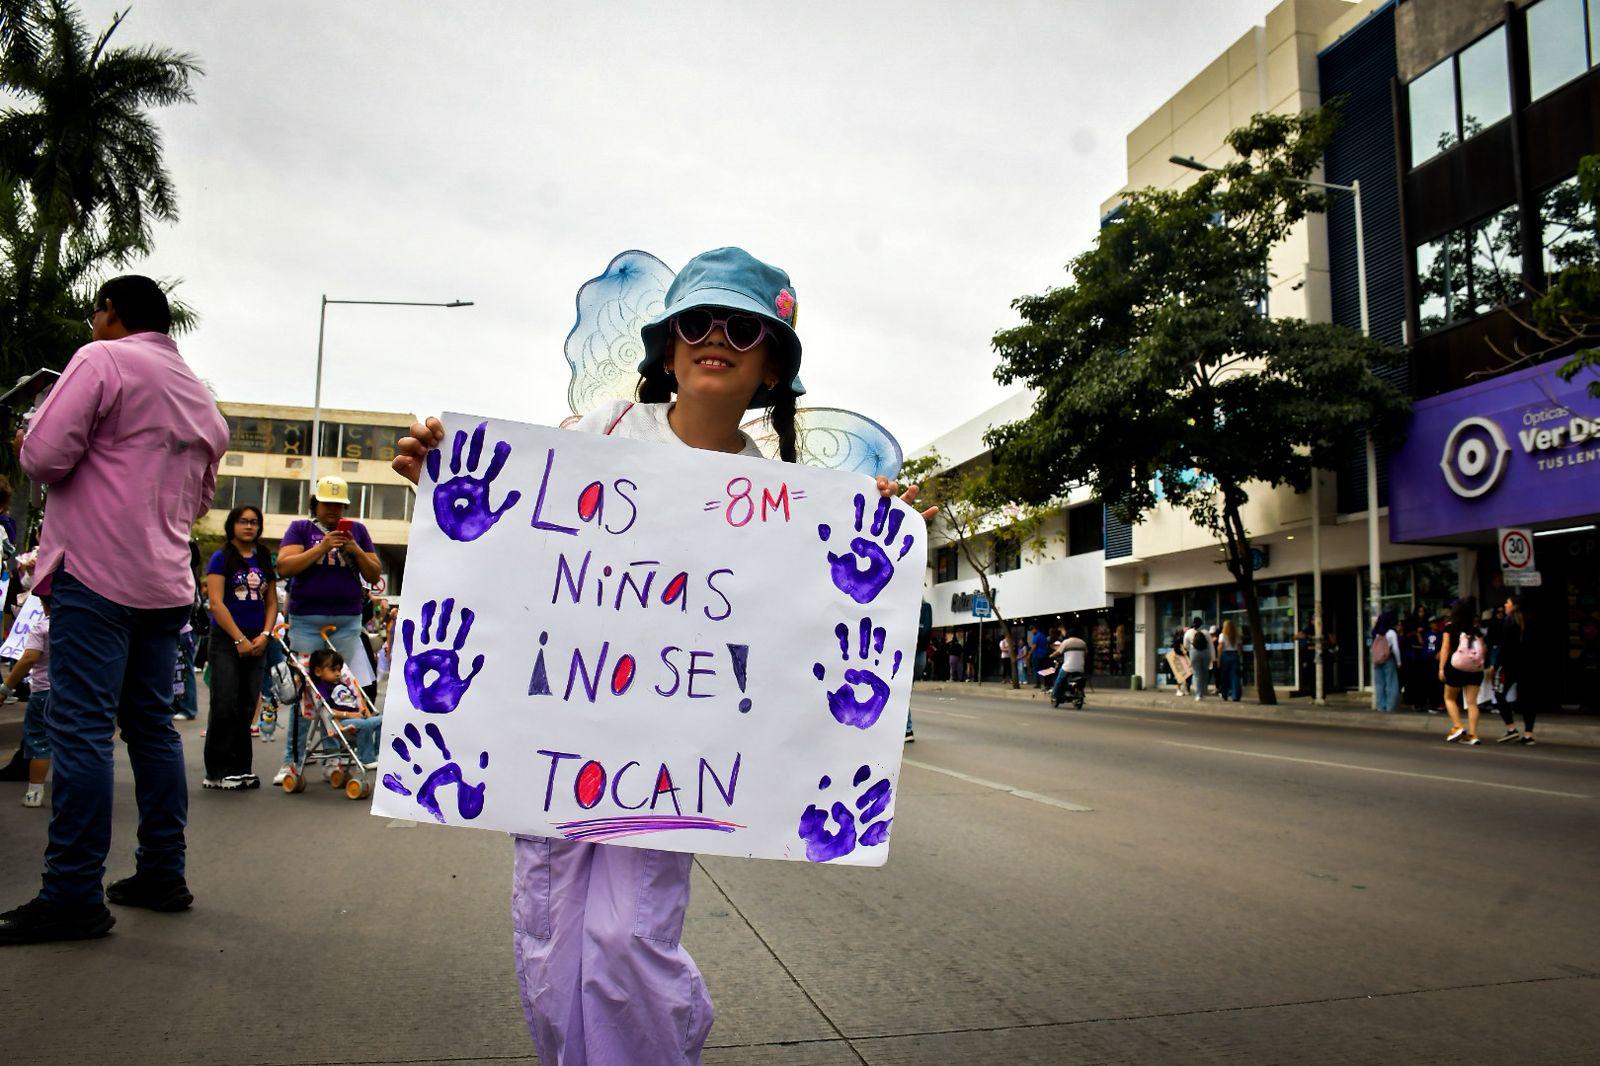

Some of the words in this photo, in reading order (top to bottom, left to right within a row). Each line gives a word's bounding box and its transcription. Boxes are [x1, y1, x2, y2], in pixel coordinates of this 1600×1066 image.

[1518, 426, 1566, 454] Ver
[1537, 456, 1564, 471] TUS
[1508, 537, 1525, 554] 30
[536, 749, 742, 817] TOCAN
